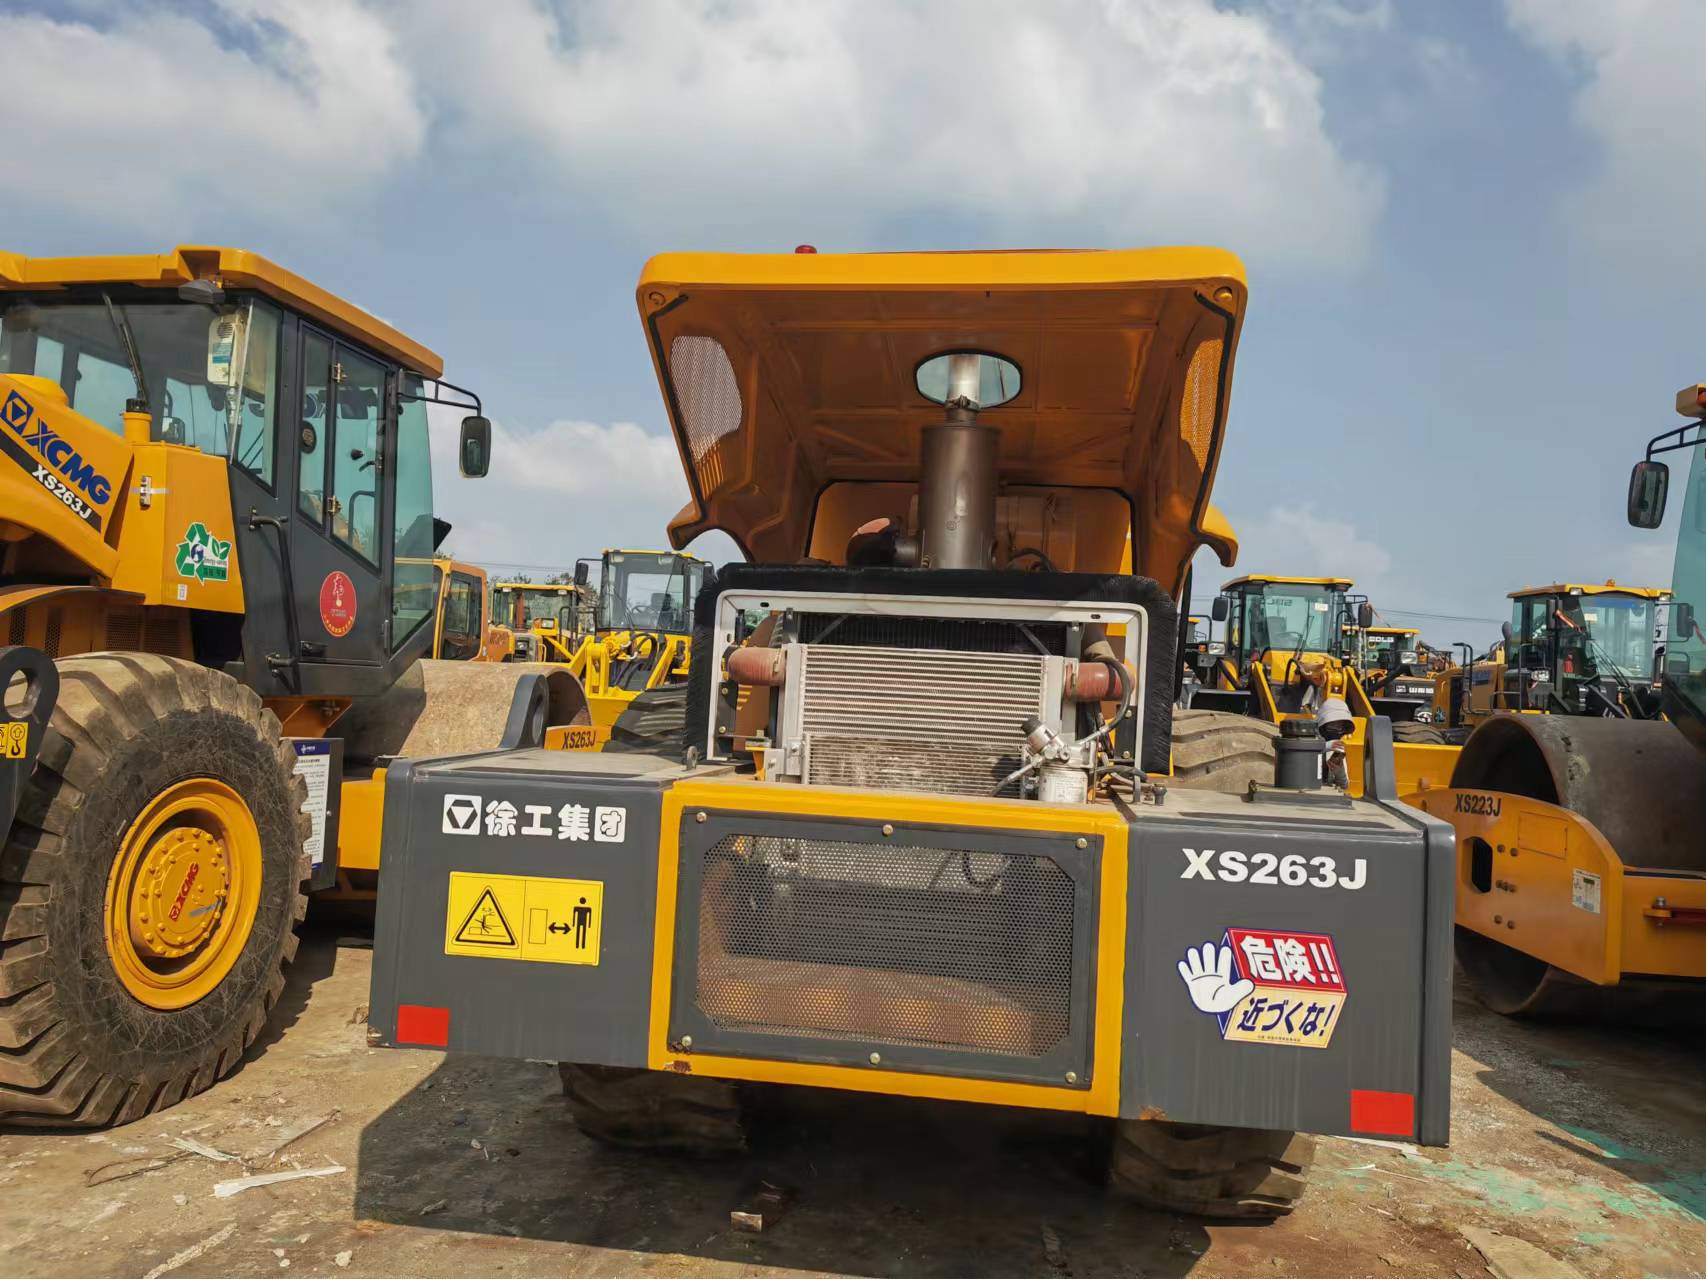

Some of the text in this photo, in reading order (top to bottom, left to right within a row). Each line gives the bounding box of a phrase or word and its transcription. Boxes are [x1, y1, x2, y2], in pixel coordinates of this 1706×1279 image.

[22, 416, 111, 505] XCMG
[32, 464, 93, 519] XS263J
[562, 731, 596, 750] XS263J
[485, 800, 627, 843] 徐工集团
[1456, 793, 1502, 816] XS223J
[176, 862, 199, 911] XCMG
[1180, 848, 1368, 890] XS263J
[1240, 935, 1340, 985] 危険!!
[1237, 997, 1336, 1037] 近づくな!
